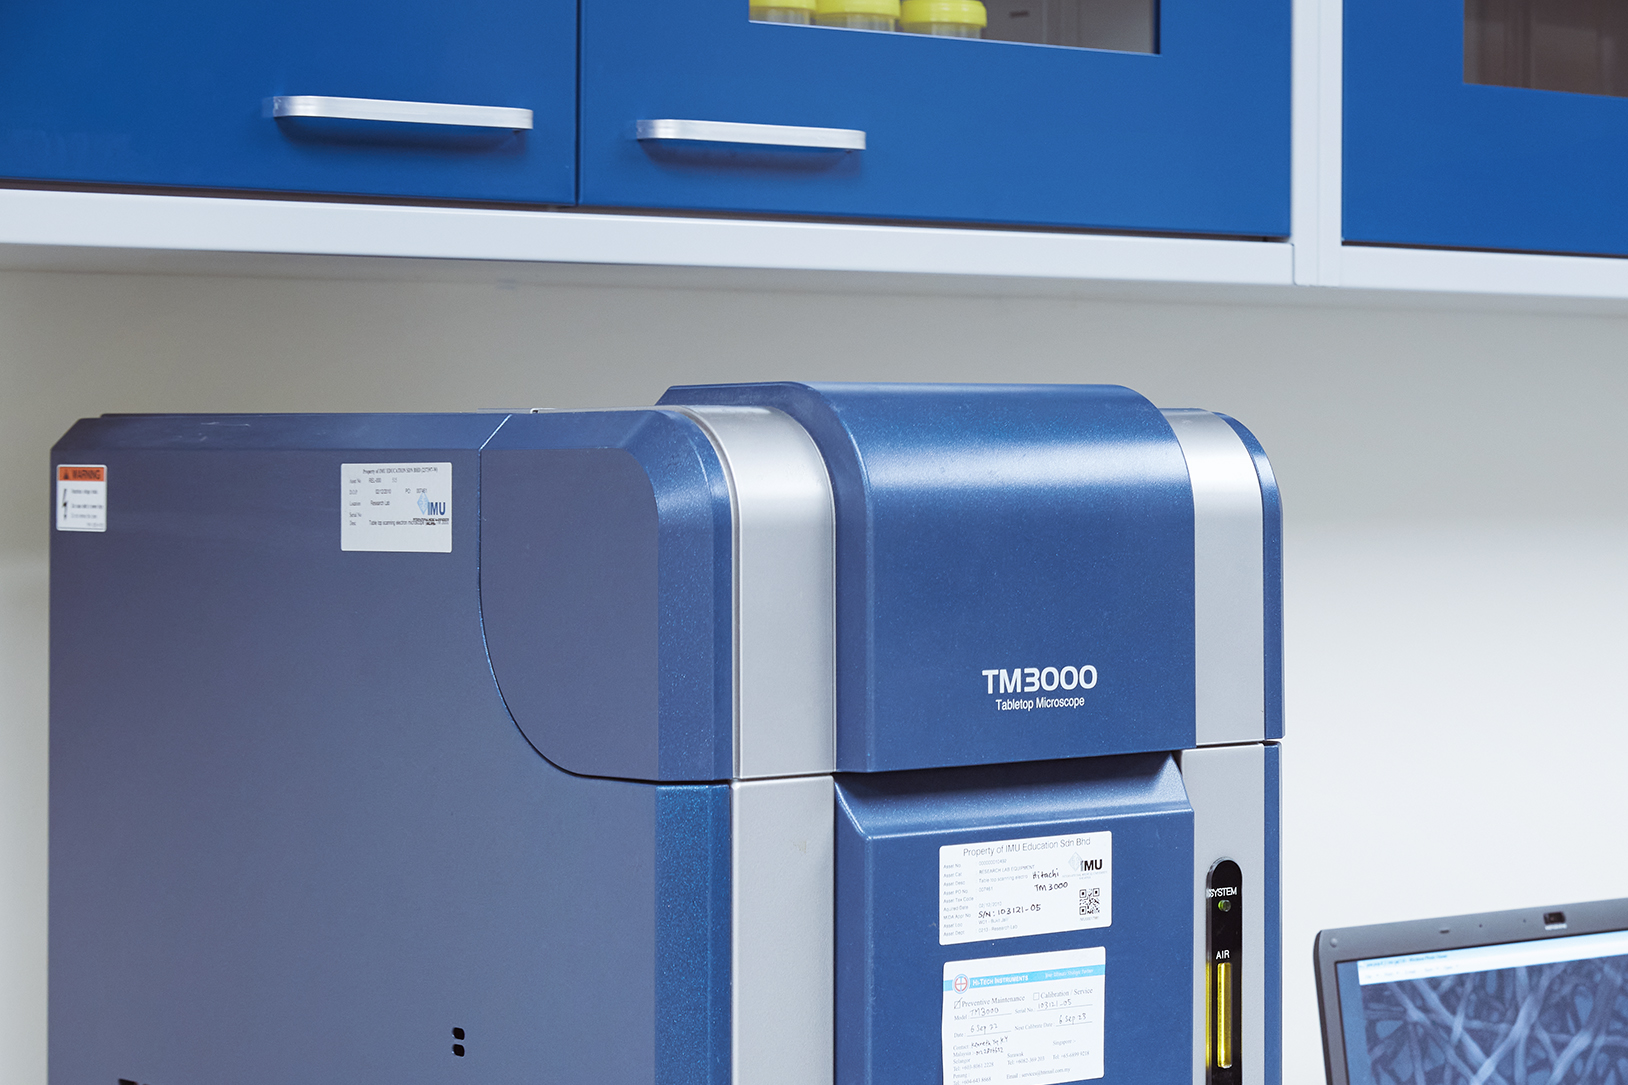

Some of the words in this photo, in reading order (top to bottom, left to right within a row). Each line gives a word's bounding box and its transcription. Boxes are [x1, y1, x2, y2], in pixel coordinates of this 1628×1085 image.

[427, 502, 446, 515] IMU
[982, 664, 1098, 695] TM3000
[995, 698, 1034, 712] Tabletop
[1036, 697, 1085, 709] Microscope
[963, 847, 995, 857] Property
[996, 845, 1004, 854] of
[1005, 843, 1020, 853] IMU
[1022, 841, 1058, 852] Education
[1060, 839, 1074, 848] Sdn
[1076, 837, 1091, 846] Bhd
[1080, 859, 1103, 871] IMU
[1209, 887, 1237, 898] SYSTEM
[1215, 949, 1230, 960] AIR
[1040, 991, 1069, 999] Calibration
[1074, 988, 1093, 996] Service
[961, 1000, 990, 1008] Preventive
[992, 996, 1025, 1004] Maintenance
